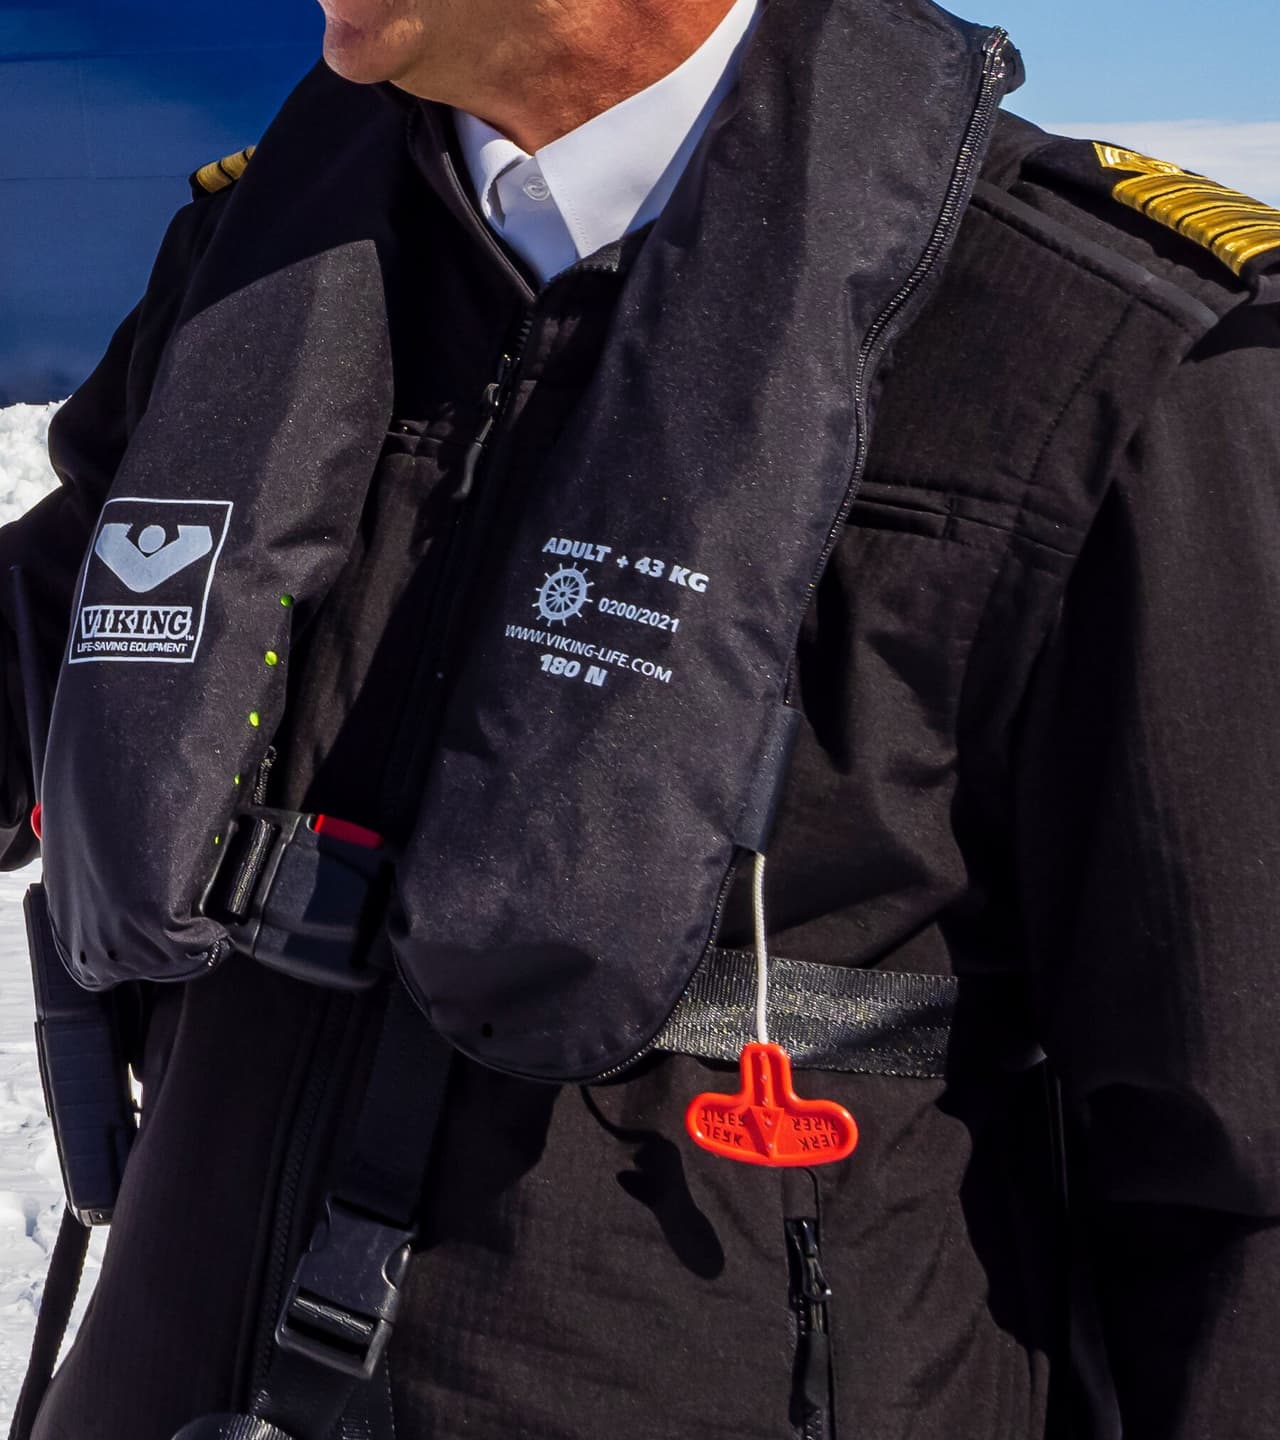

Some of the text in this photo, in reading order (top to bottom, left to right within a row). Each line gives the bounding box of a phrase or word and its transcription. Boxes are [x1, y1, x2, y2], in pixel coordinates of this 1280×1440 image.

[542, 537, 612, 562] ADULT
[635, 557, 665, 578] 43
[668, 565, 710, 593] KG
[82, 608, 191, 637] VIKING
[598, 598, 680, 633] 0200/2021
[77, 641, 188, 653] LIFE-SAVING EQUIPMENT
[505, 624, 672, 683] WWW.VIKING-LIFE.COM
[540, 654, 608, 687] 180 N
